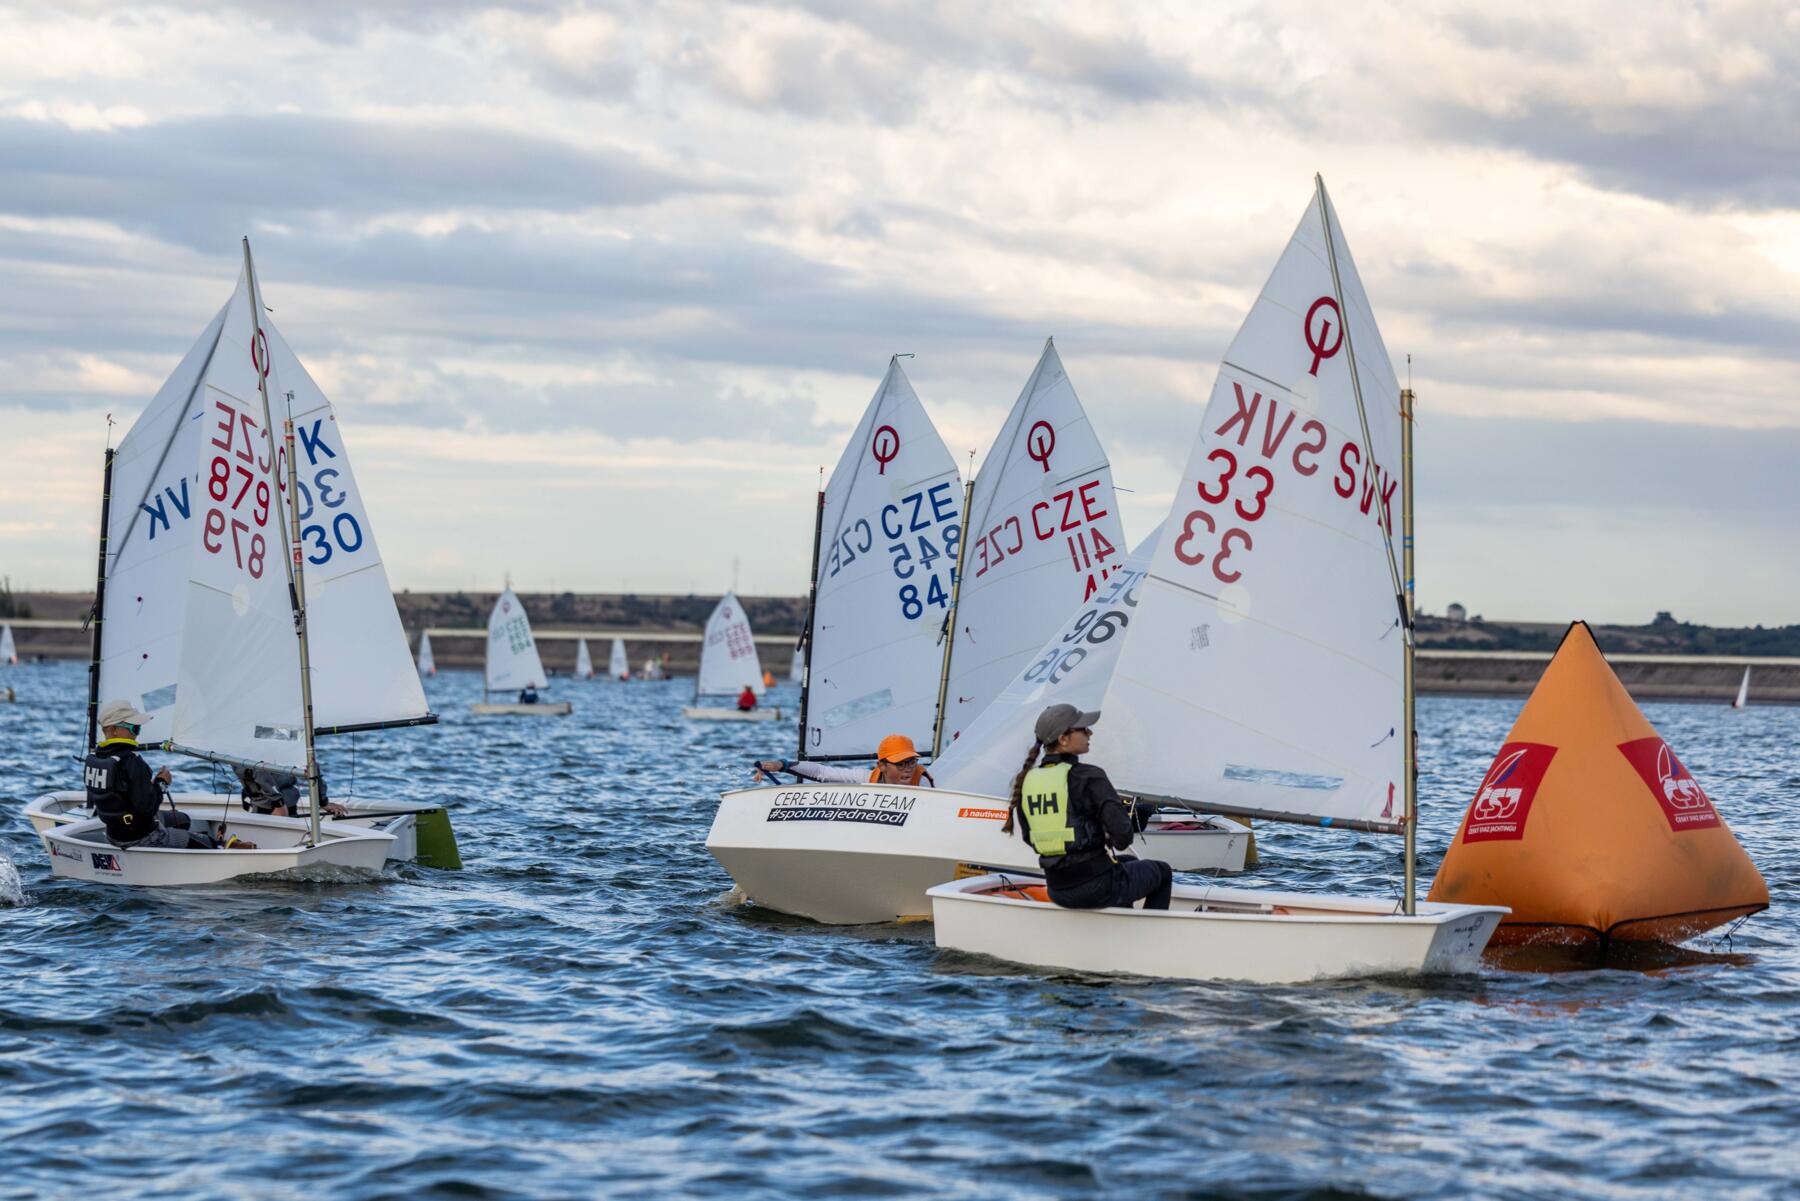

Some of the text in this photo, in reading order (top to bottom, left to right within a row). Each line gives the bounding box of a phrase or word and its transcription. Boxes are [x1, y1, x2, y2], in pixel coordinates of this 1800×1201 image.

[208, 456, 270, 527] 879
[881, 482, 958, 540] CZE
[1031, 480, 1108, 541] CZE
[1197, 448, 1274, 522] 33
[302, 512, 363, 565] 30
[85, 766, 107, 789] HH
[774, 792, 916, 811] CERE SAILING TEAM
[769, 808, 908, 823] #spolunajednelodi
[1027, 793, 1059, 816] HH
